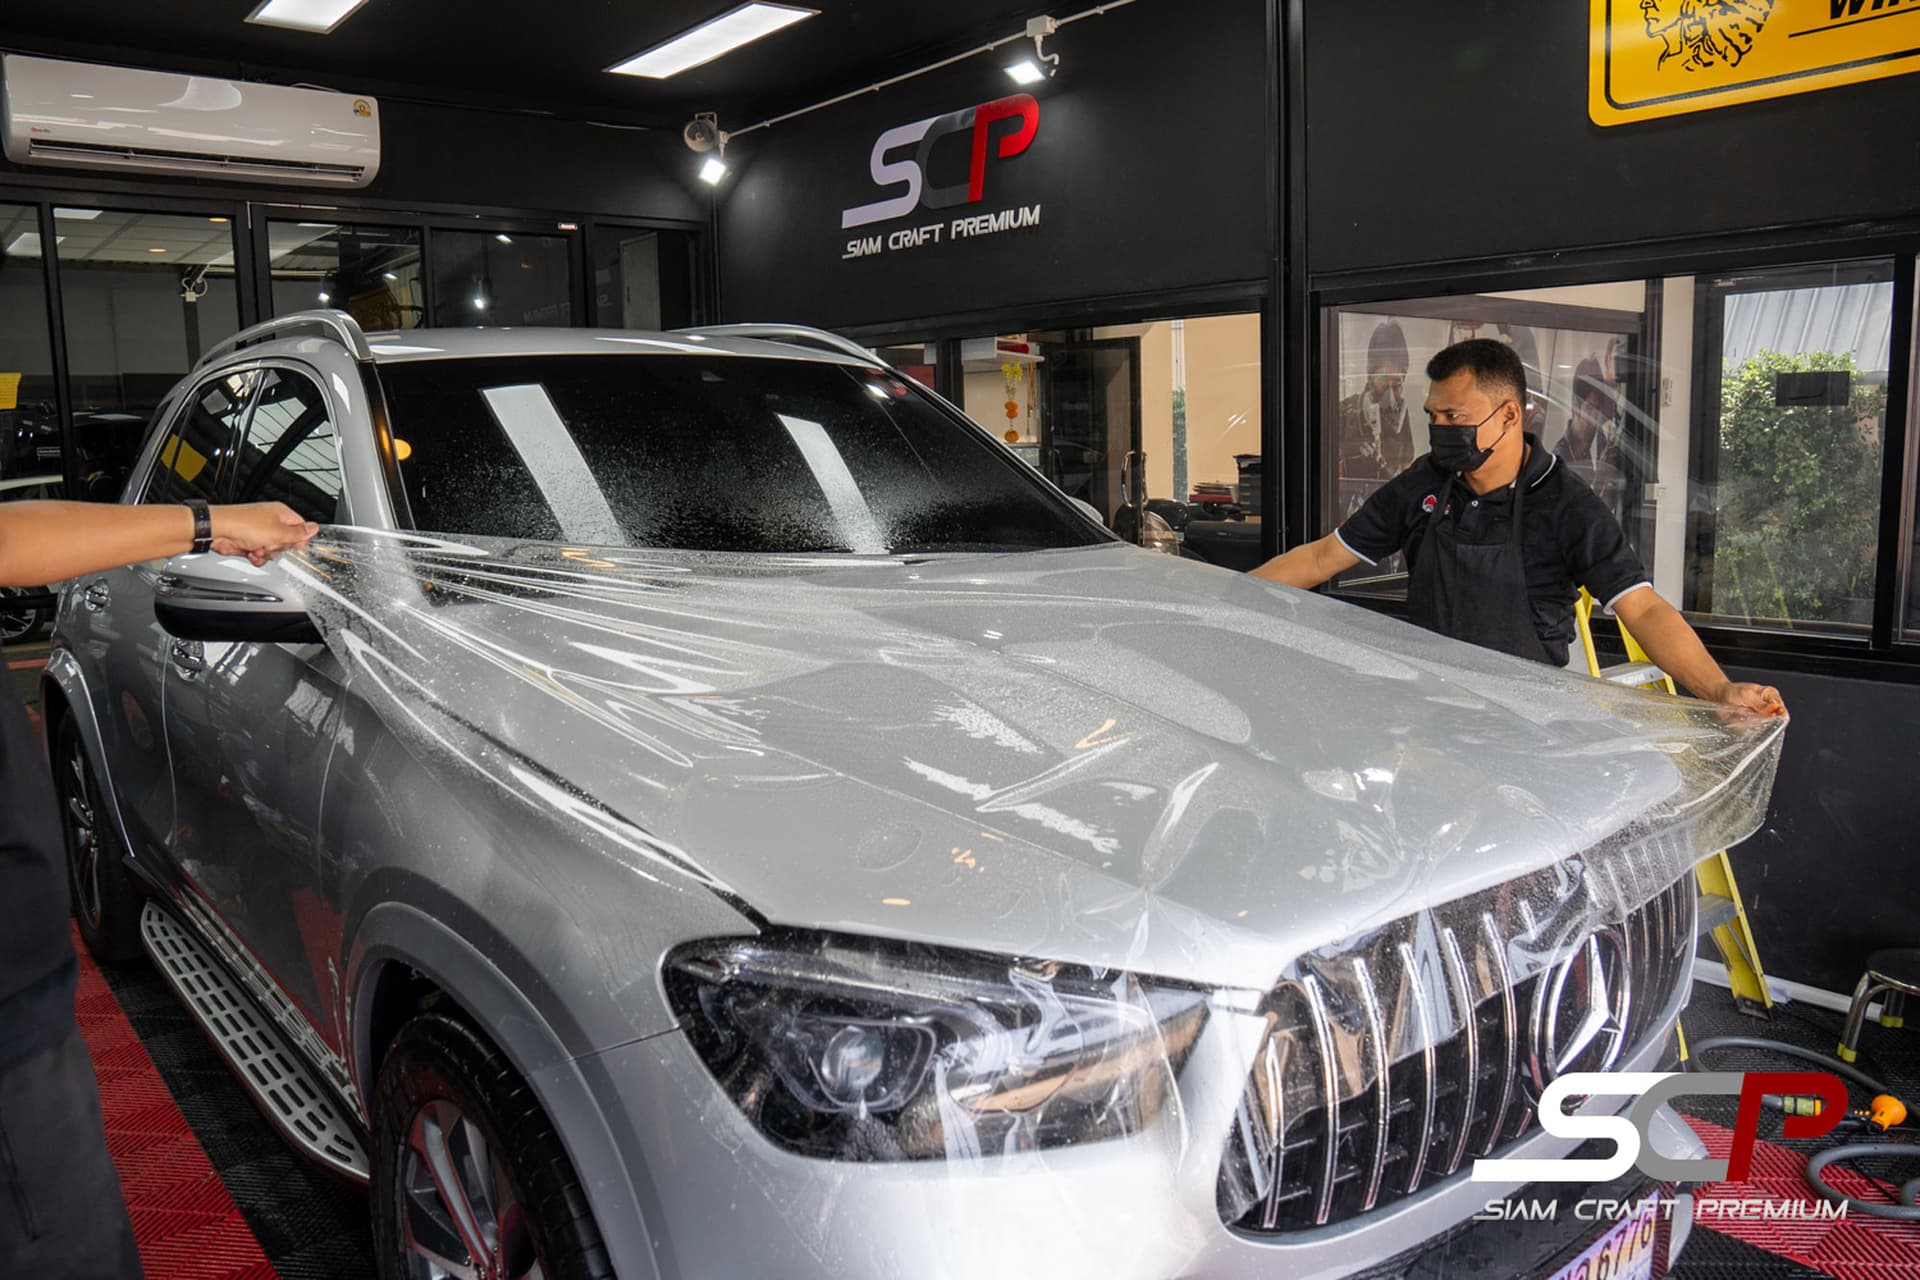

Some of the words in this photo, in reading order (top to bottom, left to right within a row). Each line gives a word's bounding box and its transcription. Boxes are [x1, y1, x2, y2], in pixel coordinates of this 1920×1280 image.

[842, 93, 1039, 229] SCP
[842, 235, 882, 260] SIAM
[888, 223, 944, 251] CRAFT
[951, 204, 1041, 240] PREMIUM
